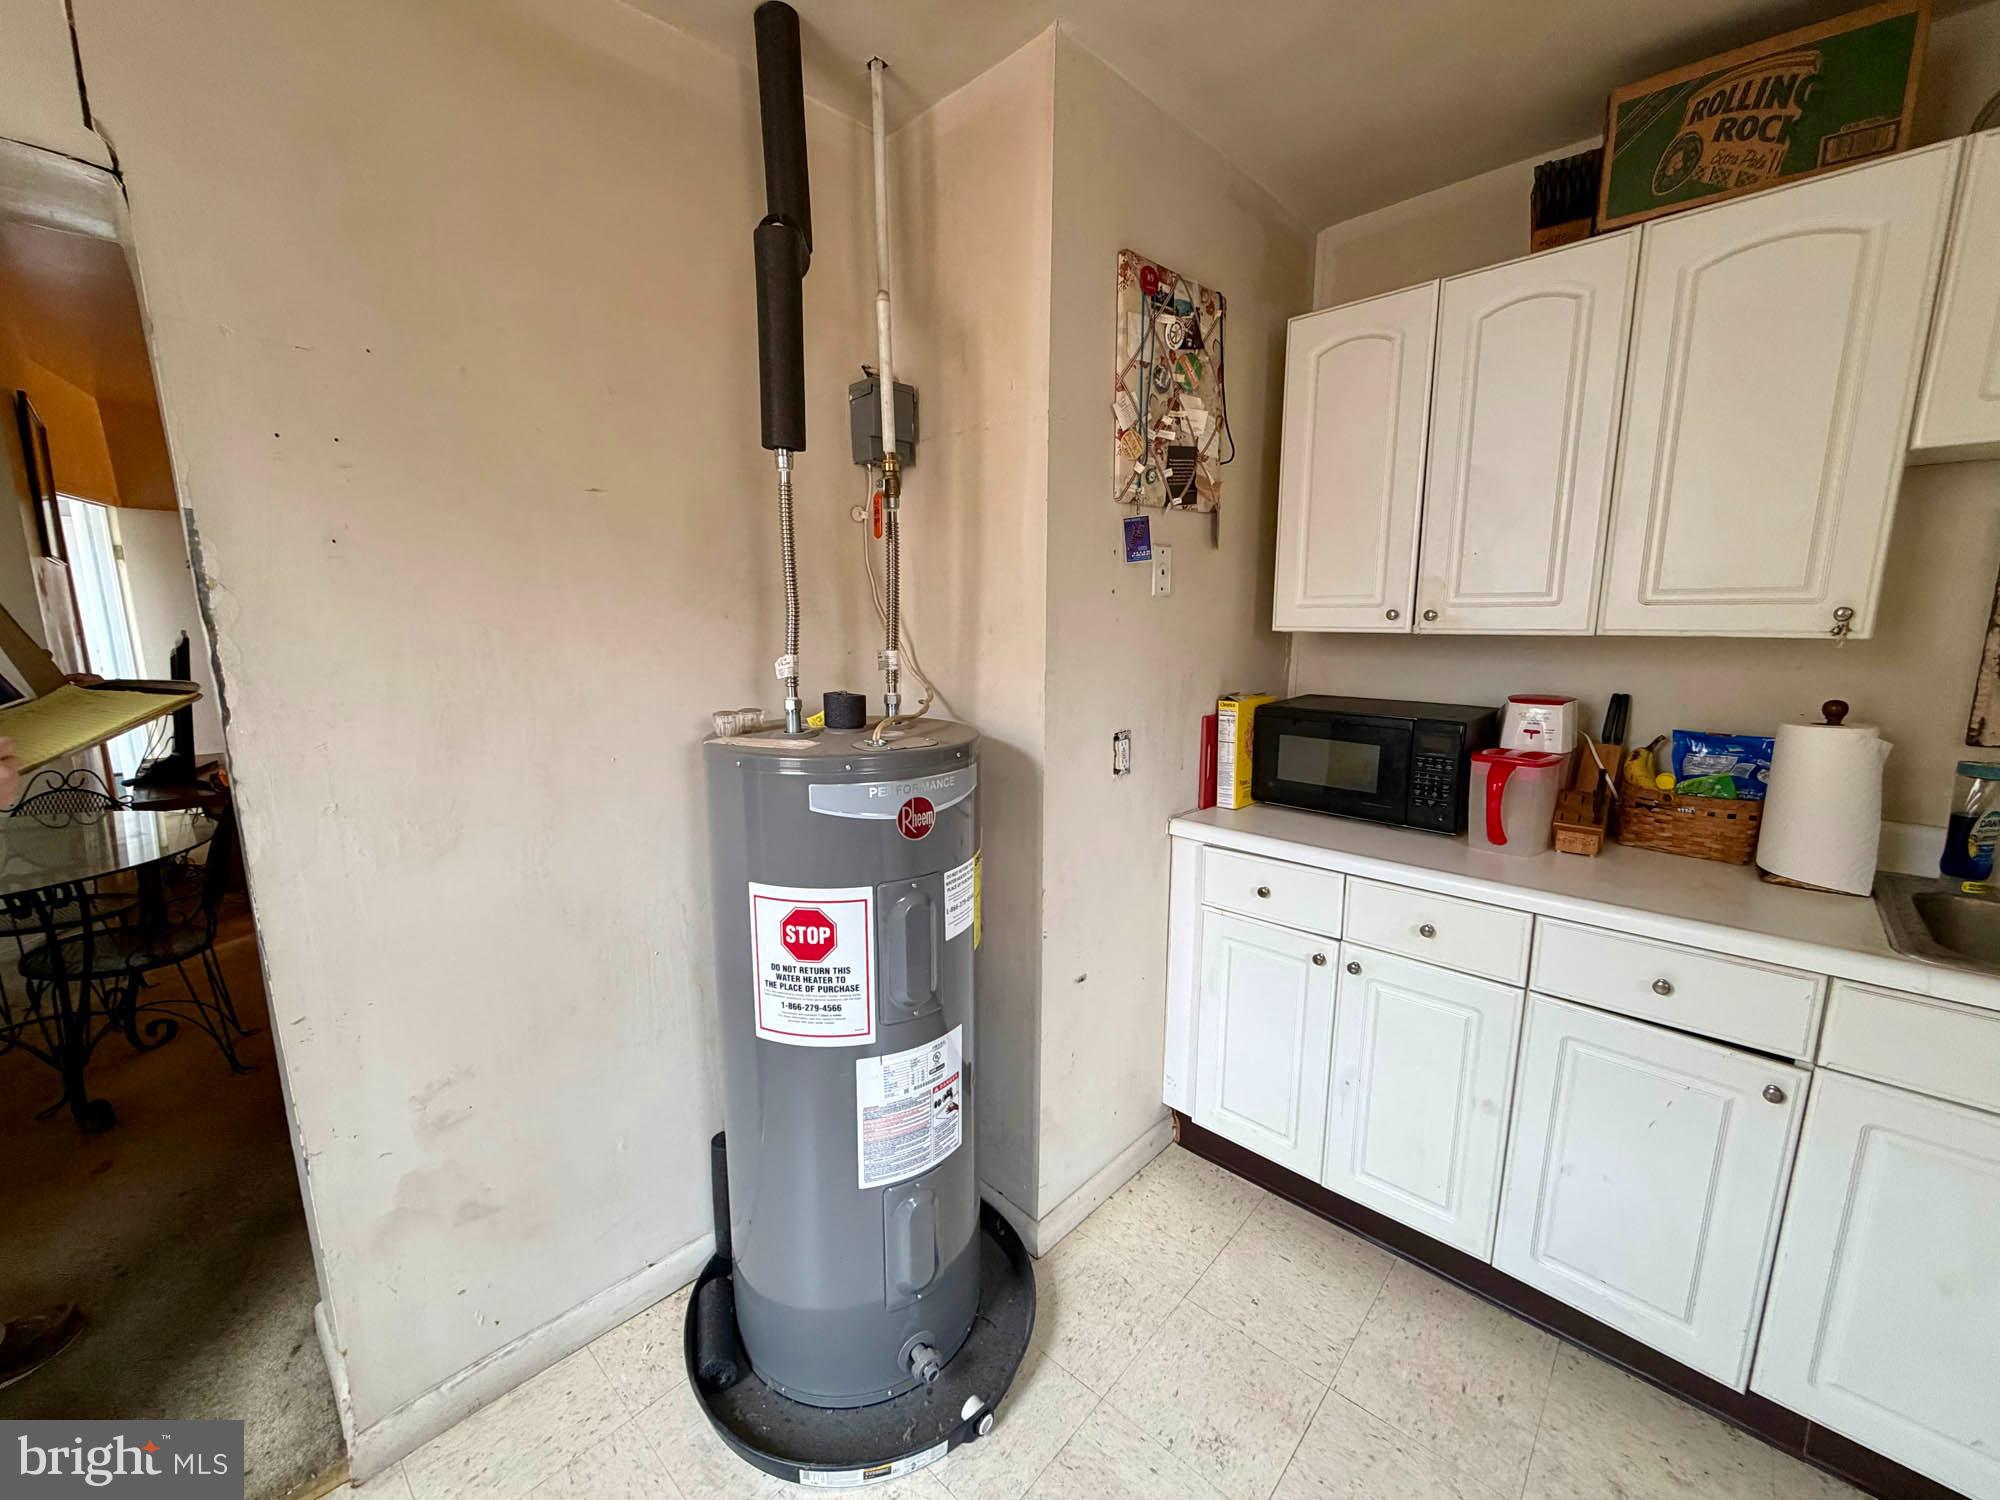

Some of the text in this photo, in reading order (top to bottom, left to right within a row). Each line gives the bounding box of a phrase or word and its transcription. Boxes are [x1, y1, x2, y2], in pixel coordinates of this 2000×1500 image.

[1712, 115, 1795, 145] ROCK
[869, 776, 955, 798] PEFORMANCE
[902, 798, 933, 833] Rheem
[785, 925, 831, 945] STOP
[771, 963, 851, 975] DO NOT RETURN THIS
[765, 979, 860, 993] THE PLACE OF PURCHASE
[775, 973, 846, 984] WATER HEATER TO
[781, 1001, 842, 1012] 1-866-279-4566
